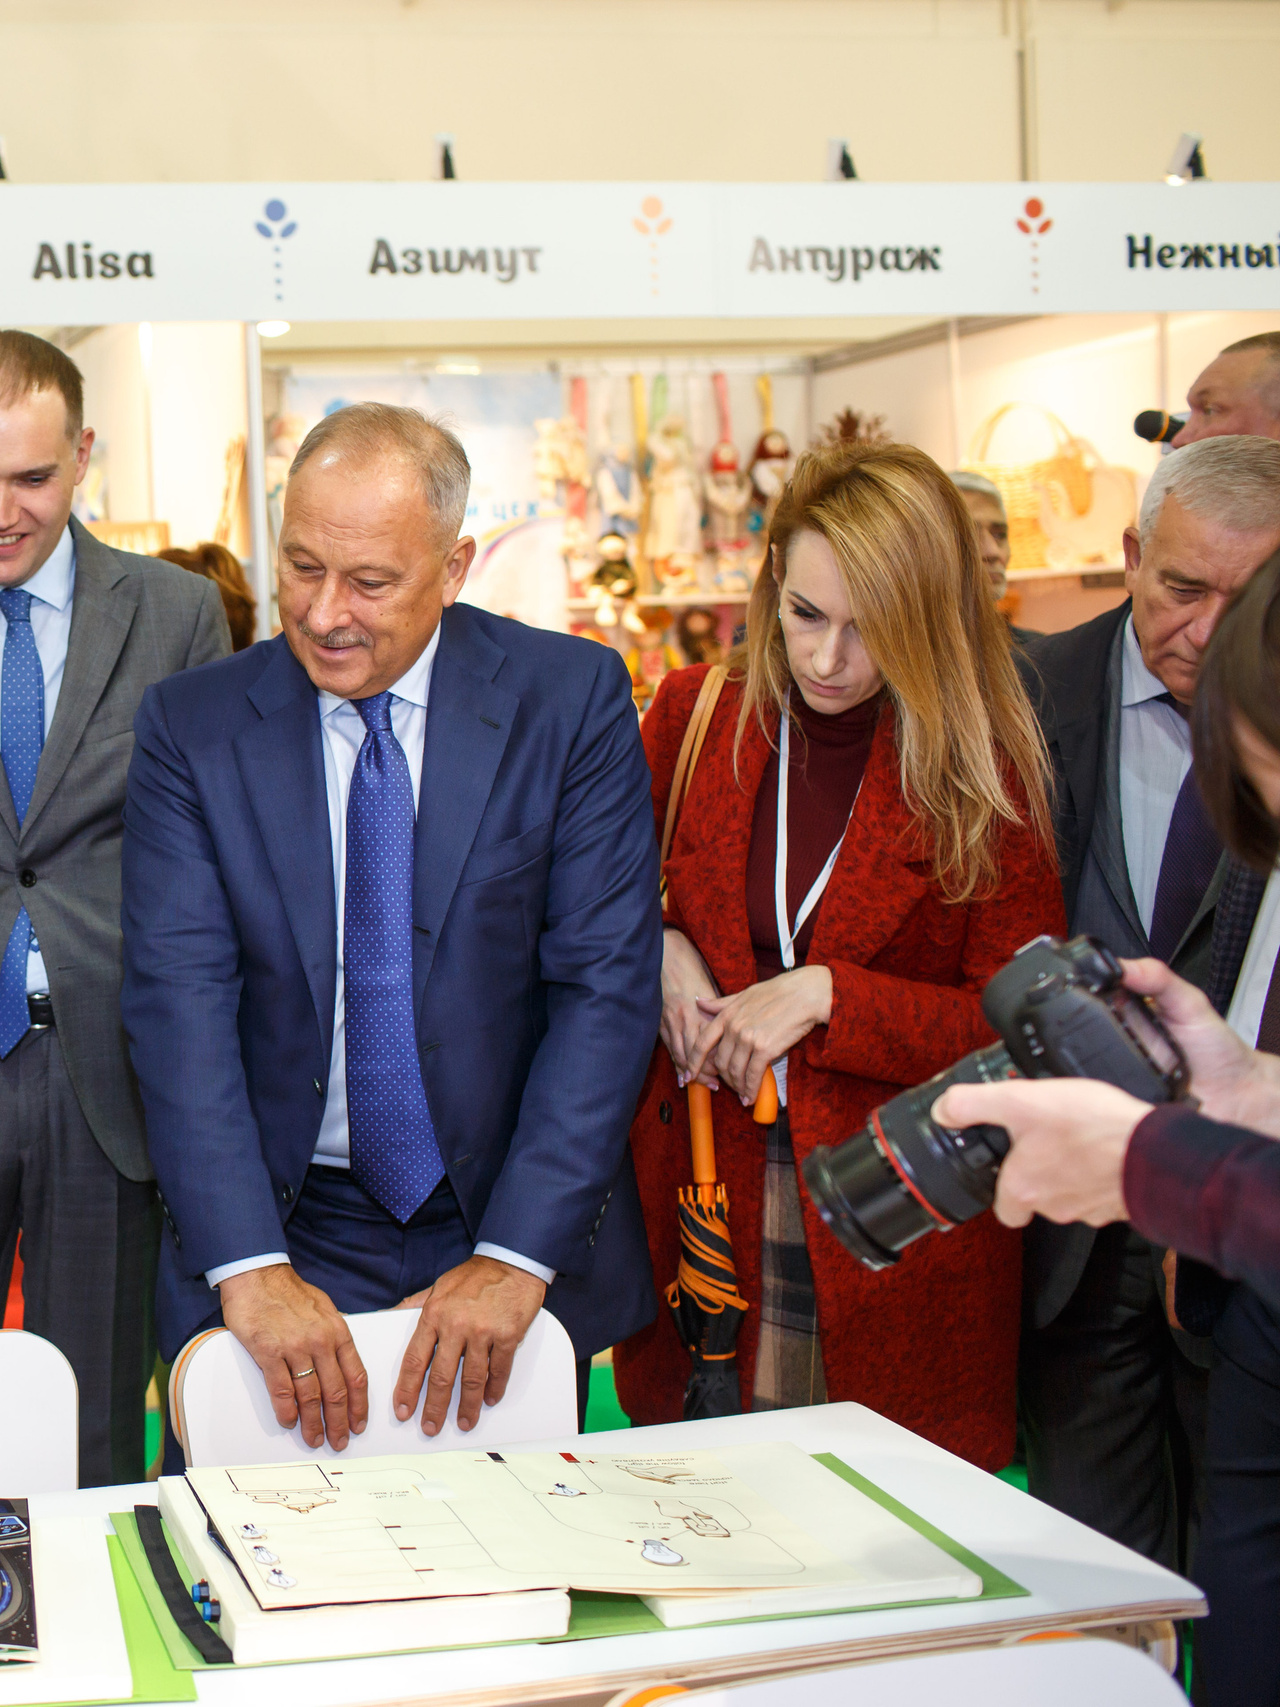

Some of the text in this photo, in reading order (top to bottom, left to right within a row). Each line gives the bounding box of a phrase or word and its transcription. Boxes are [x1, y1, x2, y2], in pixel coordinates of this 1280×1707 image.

[32, 242, 154, 280] Alisa
[369, 237, 542, 284] Азимут
[749, 236, 941, 282] Антураж
[1126, 232, 1280, 269] Нежны
